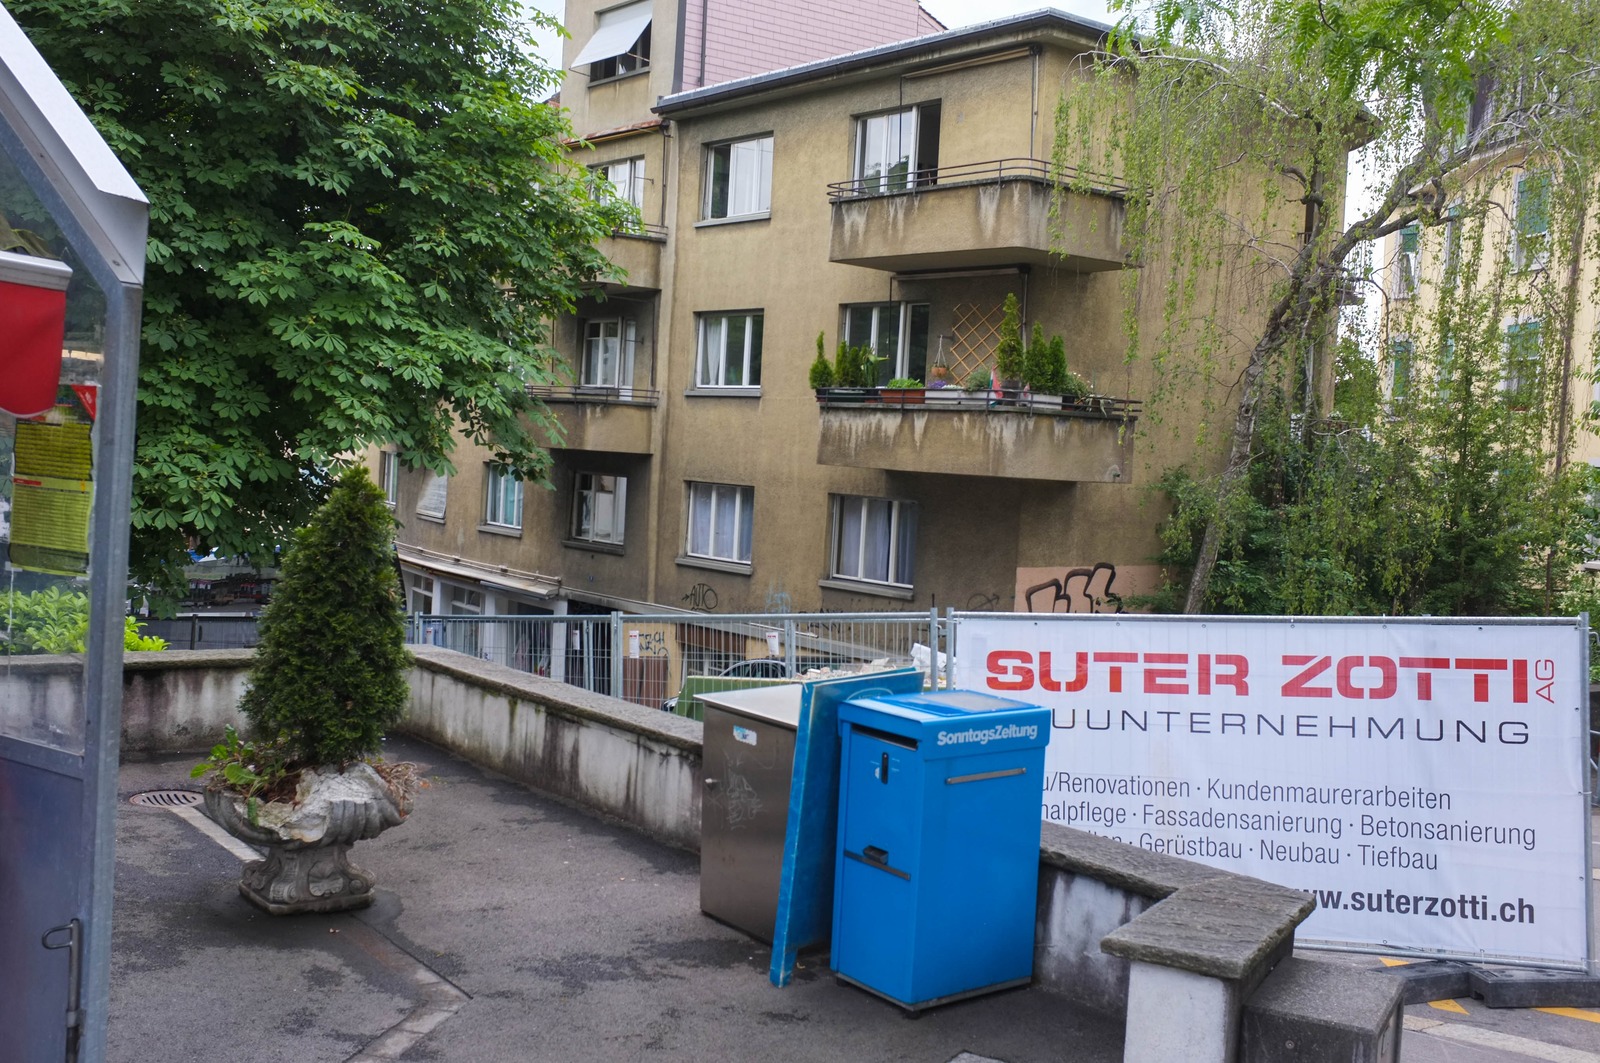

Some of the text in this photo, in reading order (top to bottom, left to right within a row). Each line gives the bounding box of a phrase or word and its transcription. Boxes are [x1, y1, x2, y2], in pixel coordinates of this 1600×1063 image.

[986, 650, 1528, 704] SUTER ZOTTI
[1535, 658, 1555, 704] AG
[937, 724, 1038, 746] SonntagsZeitung
[1052, 708, 1529, 744] UUNTERNEHMUNG
[1207, 778, 1451, 811] Kundenmaurerarbeiten
[1143, 804, 1342, 839] Fassadensanierung
[1361, 814, 1536, 850] Betonsanierung
[1139, 832, 1242, 859] Gerüstbau
[1260, 839, 1340, 865] Neubau
[1357, 844, 1438, 871] Tiefbau
[1295, 888, 1535, 924] w.suterzotti.ch
